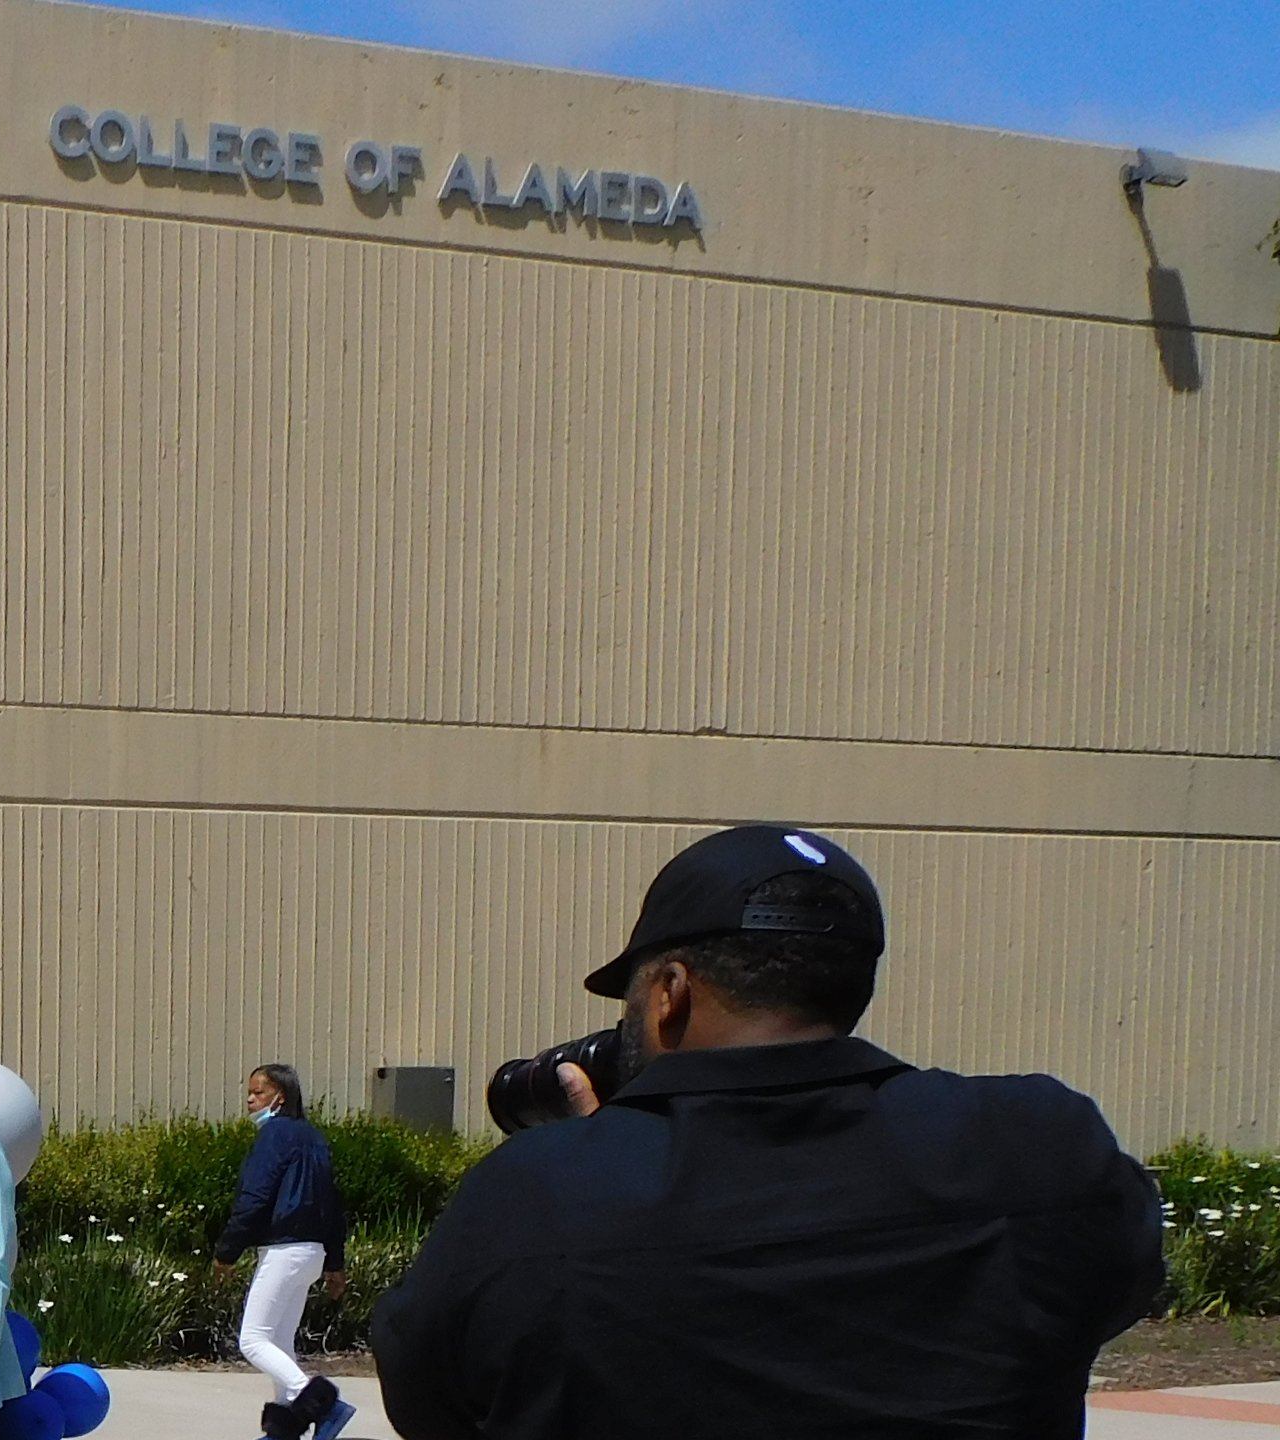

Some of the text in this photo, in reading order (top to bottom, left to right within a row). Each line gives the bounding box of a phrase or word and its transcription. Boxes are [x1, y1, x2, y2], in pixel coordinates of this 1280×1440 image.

[49, 104, 705, 228] COLLEGE OF ALAMEDA
